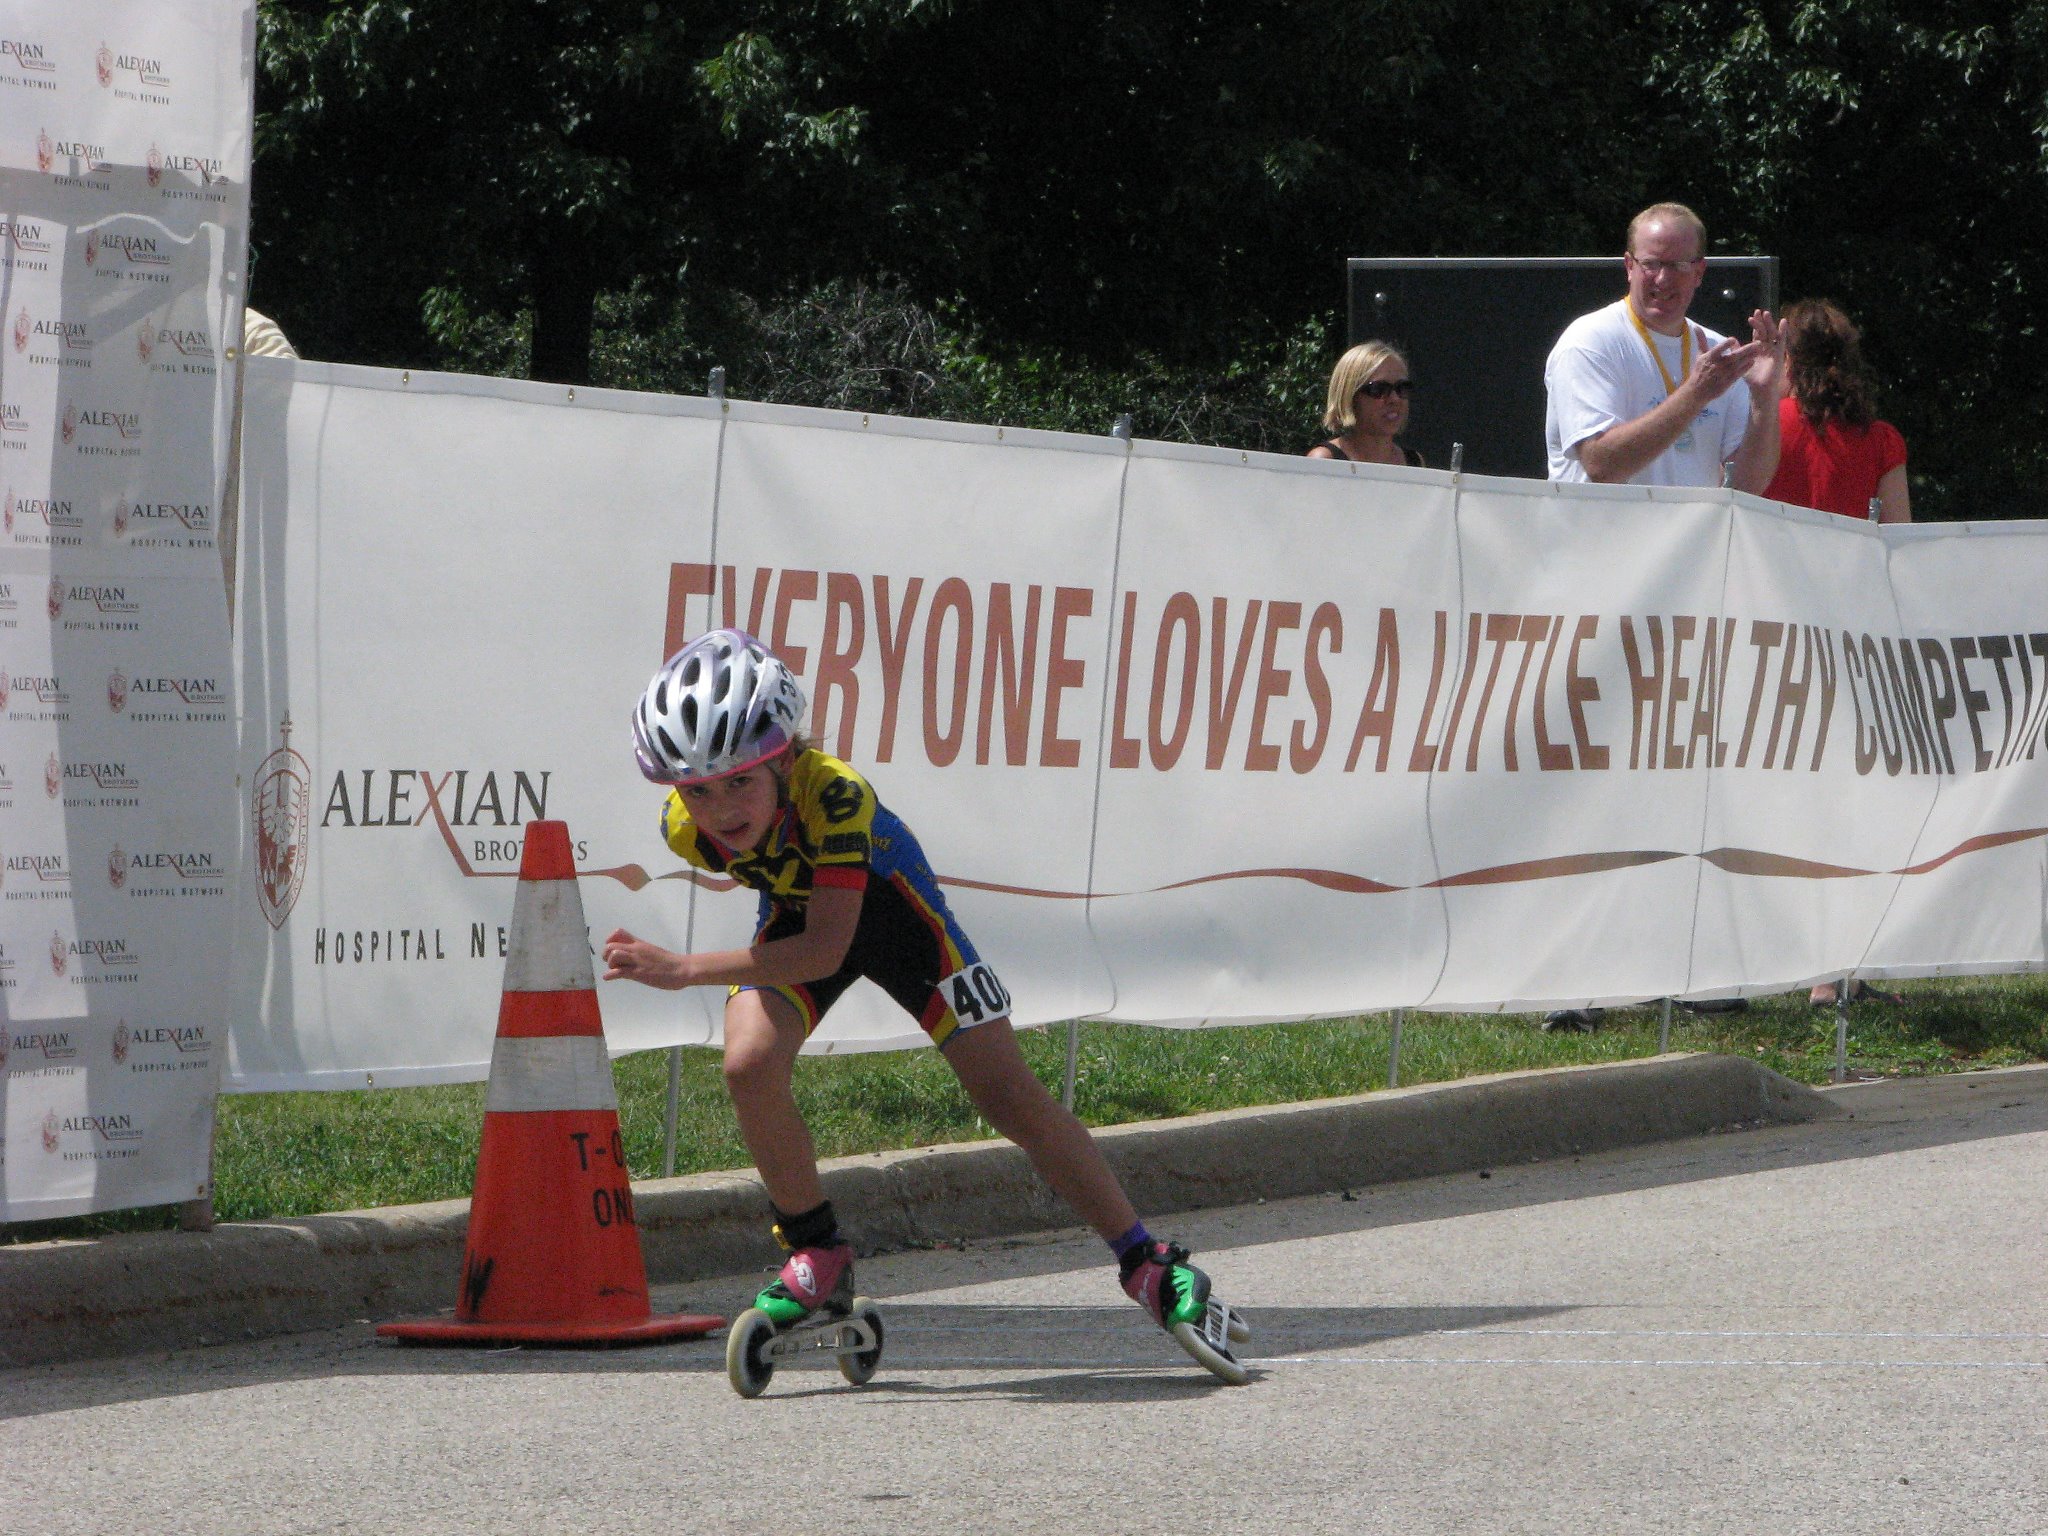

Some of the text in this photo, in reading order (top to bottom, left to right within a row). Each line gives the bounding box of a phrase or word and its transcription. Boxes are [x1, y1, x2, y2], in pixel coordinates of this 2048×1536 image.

[0, 40, 43, 59] EXIAN
[116, 55, 161, 75] ALEXIAN
[56, 141, 105, 159] ALEXIAN
[100, 234, 156, 252] ALEXIAN
[33, 320, 87, 337] ALEXIAN
[158, 328, 207, 347] EXIAN
[16, 499, 72, 515] ALEXIAN
[68, 586, 125, 601] ALEXIAN
[11, 677, 60, 691] ALEXIAN
[131, 679, 215, 693] ALEXIAN
[1109, 591, 1343, 775] LOVES
[1343, 607, 1401, 773] A
[1408, 610, 1610, 772] LITTLE
[1619, 615, 1837, 772] HEALTHY
[1842, 632, 2048, 777] COMPETIT
[63, 763, 126, 778] ALEXIAN
[320, 769, 552, 828] ALEXIAN
[474, 840, 588, 861] BROS
[6, 855, 61, 871] ALEXIAN
[131, 853, 211, 869] ALEXIAN
[69, 938, 126, 955] ALEXIAN
[315, 927, 445, 965] HOSPITAL
[12, 1032, 70, 1051] ALEXIAN
[132, 1026, 204, 1043] ALEXIAN
[61, 1114, 131, 1131] ALEXIAN
